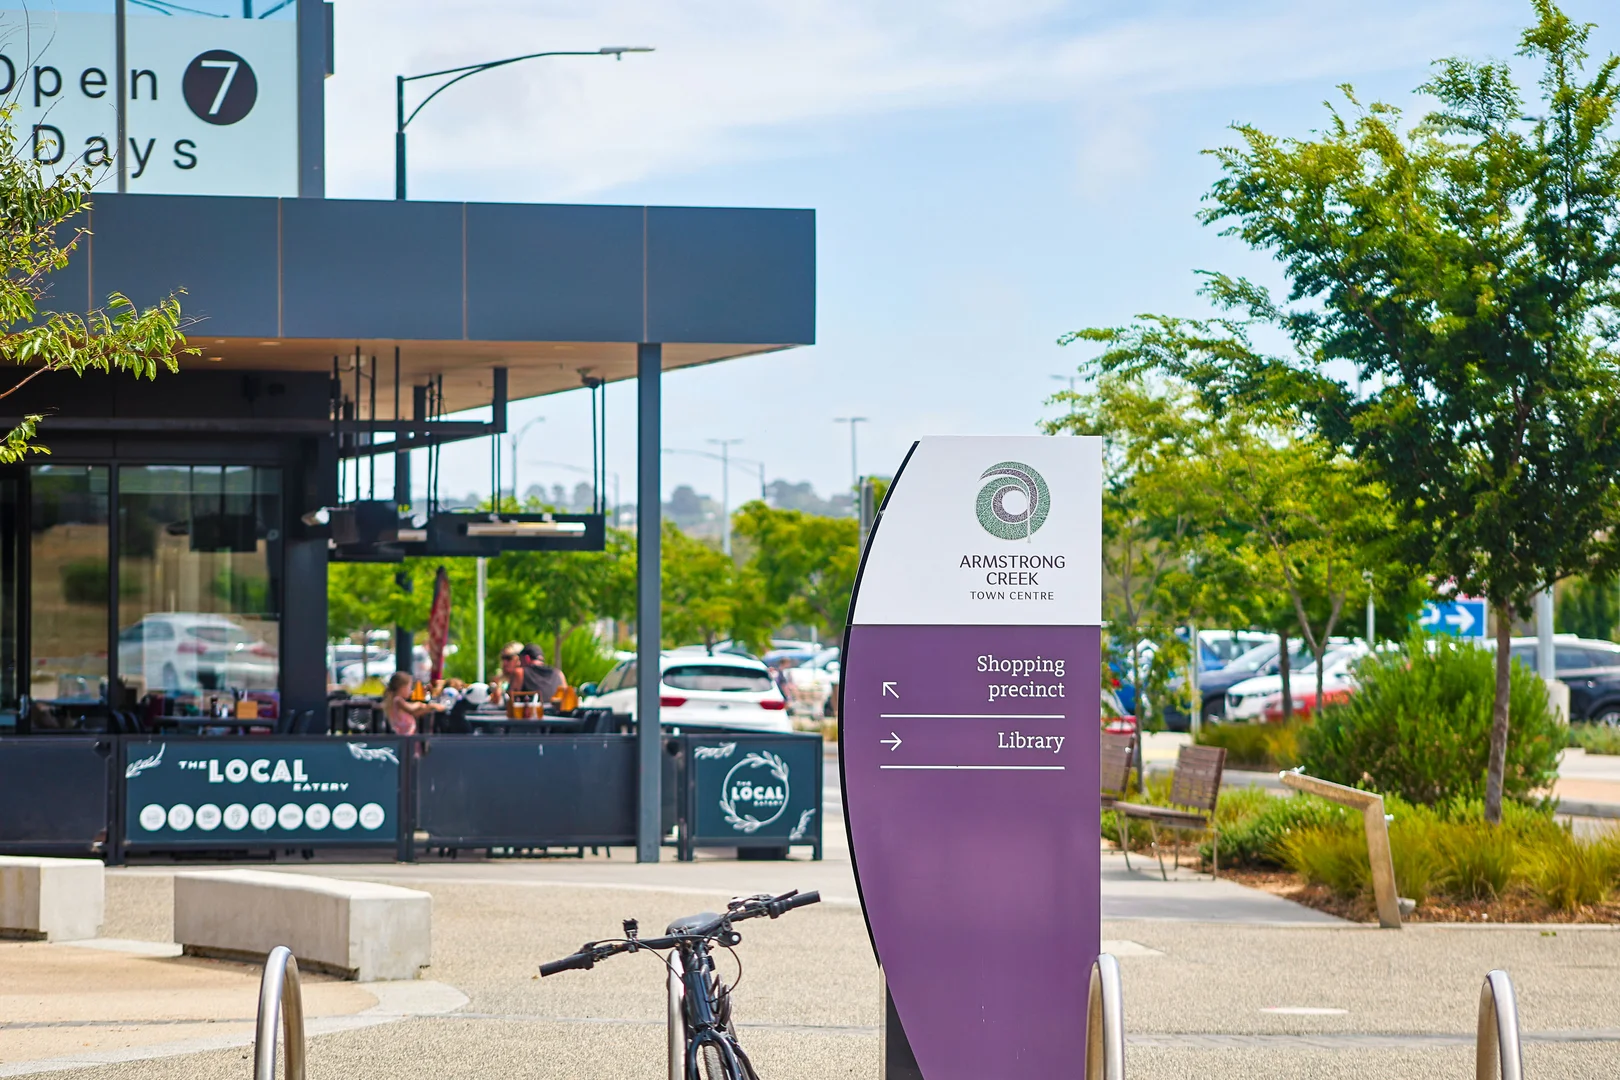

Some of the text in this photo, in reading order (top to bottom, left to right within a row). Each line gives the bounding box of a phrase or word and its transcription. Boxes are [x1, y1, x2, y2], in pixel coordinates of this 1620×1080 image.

[201, 60, 240, 115] 7
[32, 124, 198, 179] Days
[959, 555, 1066, 569] ARMSTRONG
[986, 572, 1039, 586] CREEK
[970, 591, 1054, 601] TOWN CENTRE
[977, 655, 1066, 677] Shopping
[988, 681, 1066, 701] precinct
[997, 731, 1066, 754] Library
[178, 758, 309, 783] THE LOCAL
[293, 782, 349, 792] EATERY
[731, 786, 784, 800] LOCAL
